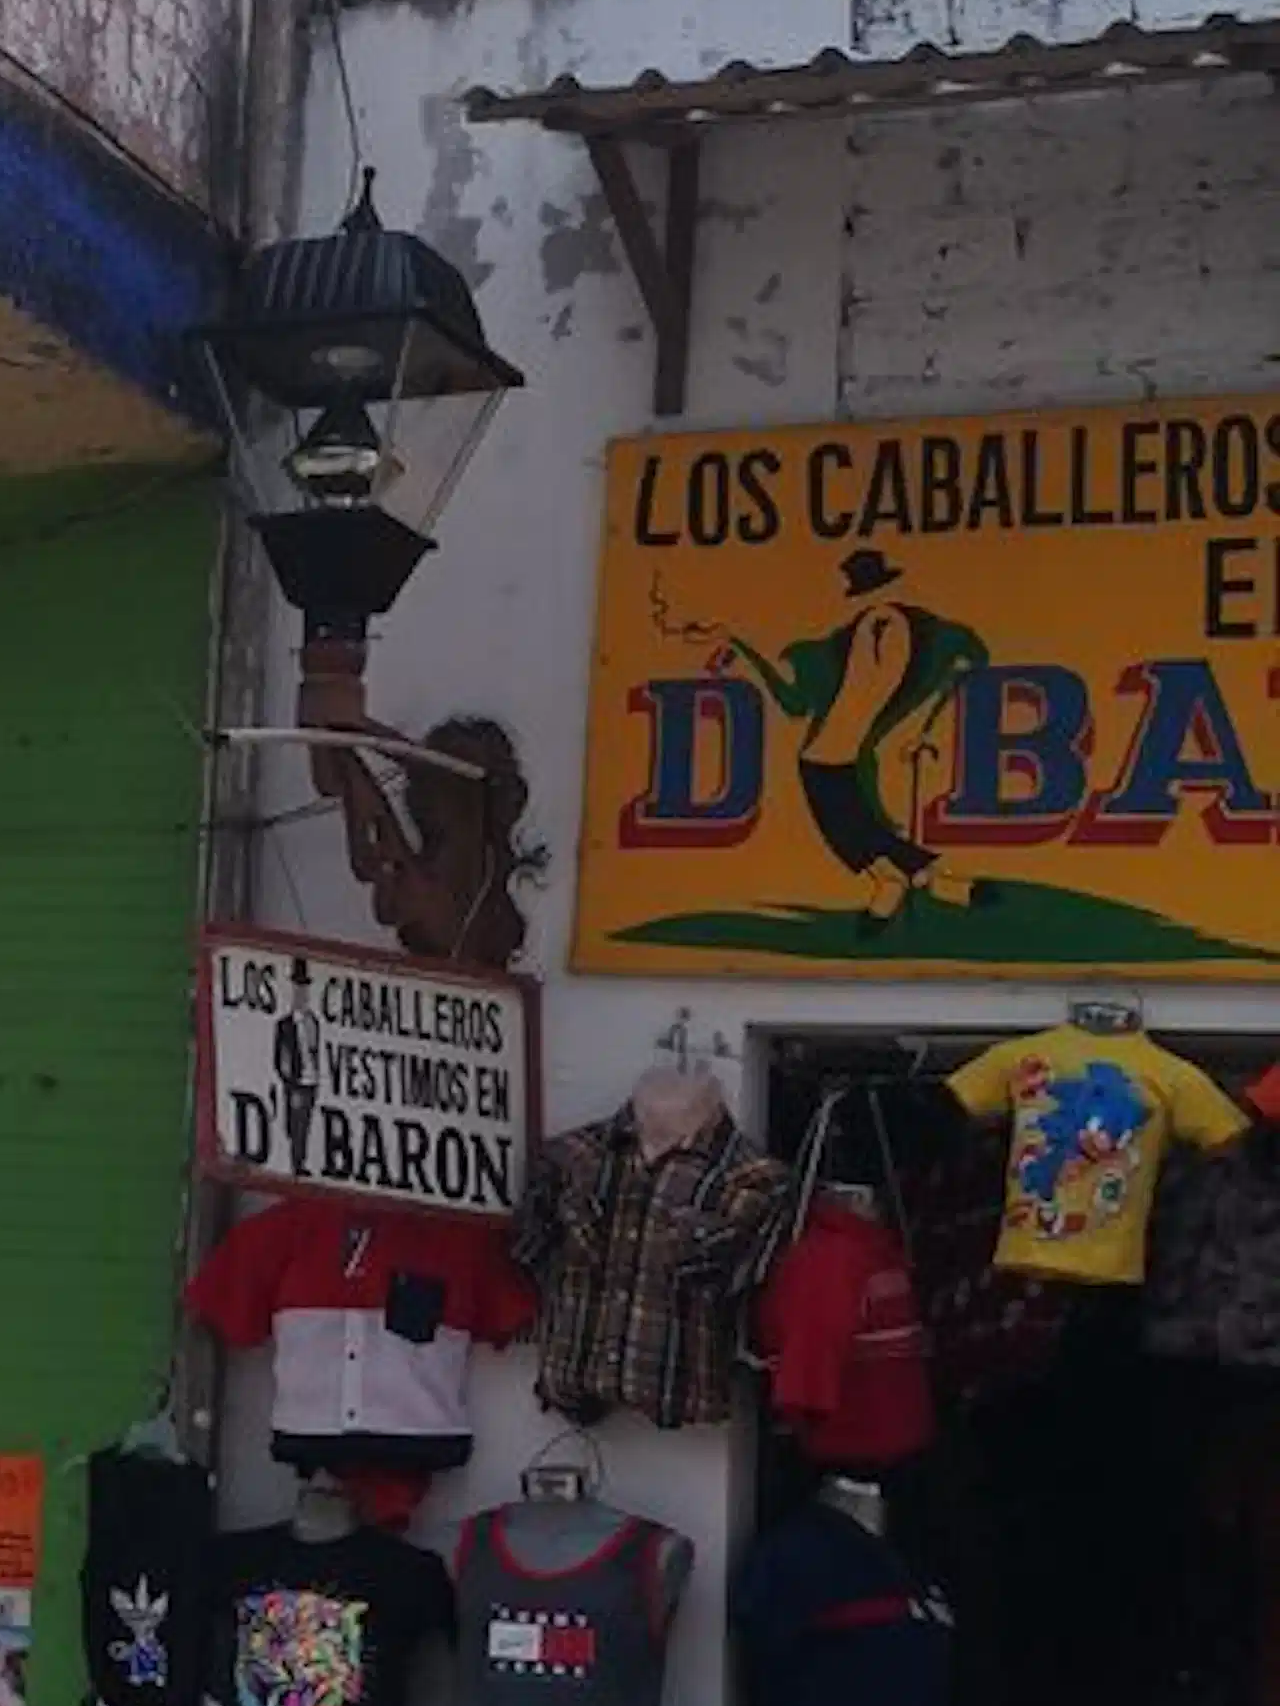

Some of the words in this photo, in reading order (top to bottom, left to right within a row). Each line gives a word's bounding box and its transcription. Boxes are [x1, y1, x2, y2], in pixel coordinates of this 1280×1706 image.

[636, 450, 780, 546] LOS
[1204, 538, 1280, 637] E
[923, 659, 1280, 849] BA
[219, 955, 277, 1014] LOS
[322, 977, 503, 1053] CABALLEROS
[326, 1040, 469, 1114] VESTIMOS
[477, 1062, 510, 1123] EN
[321, 1105, 512, 1206] BARON
